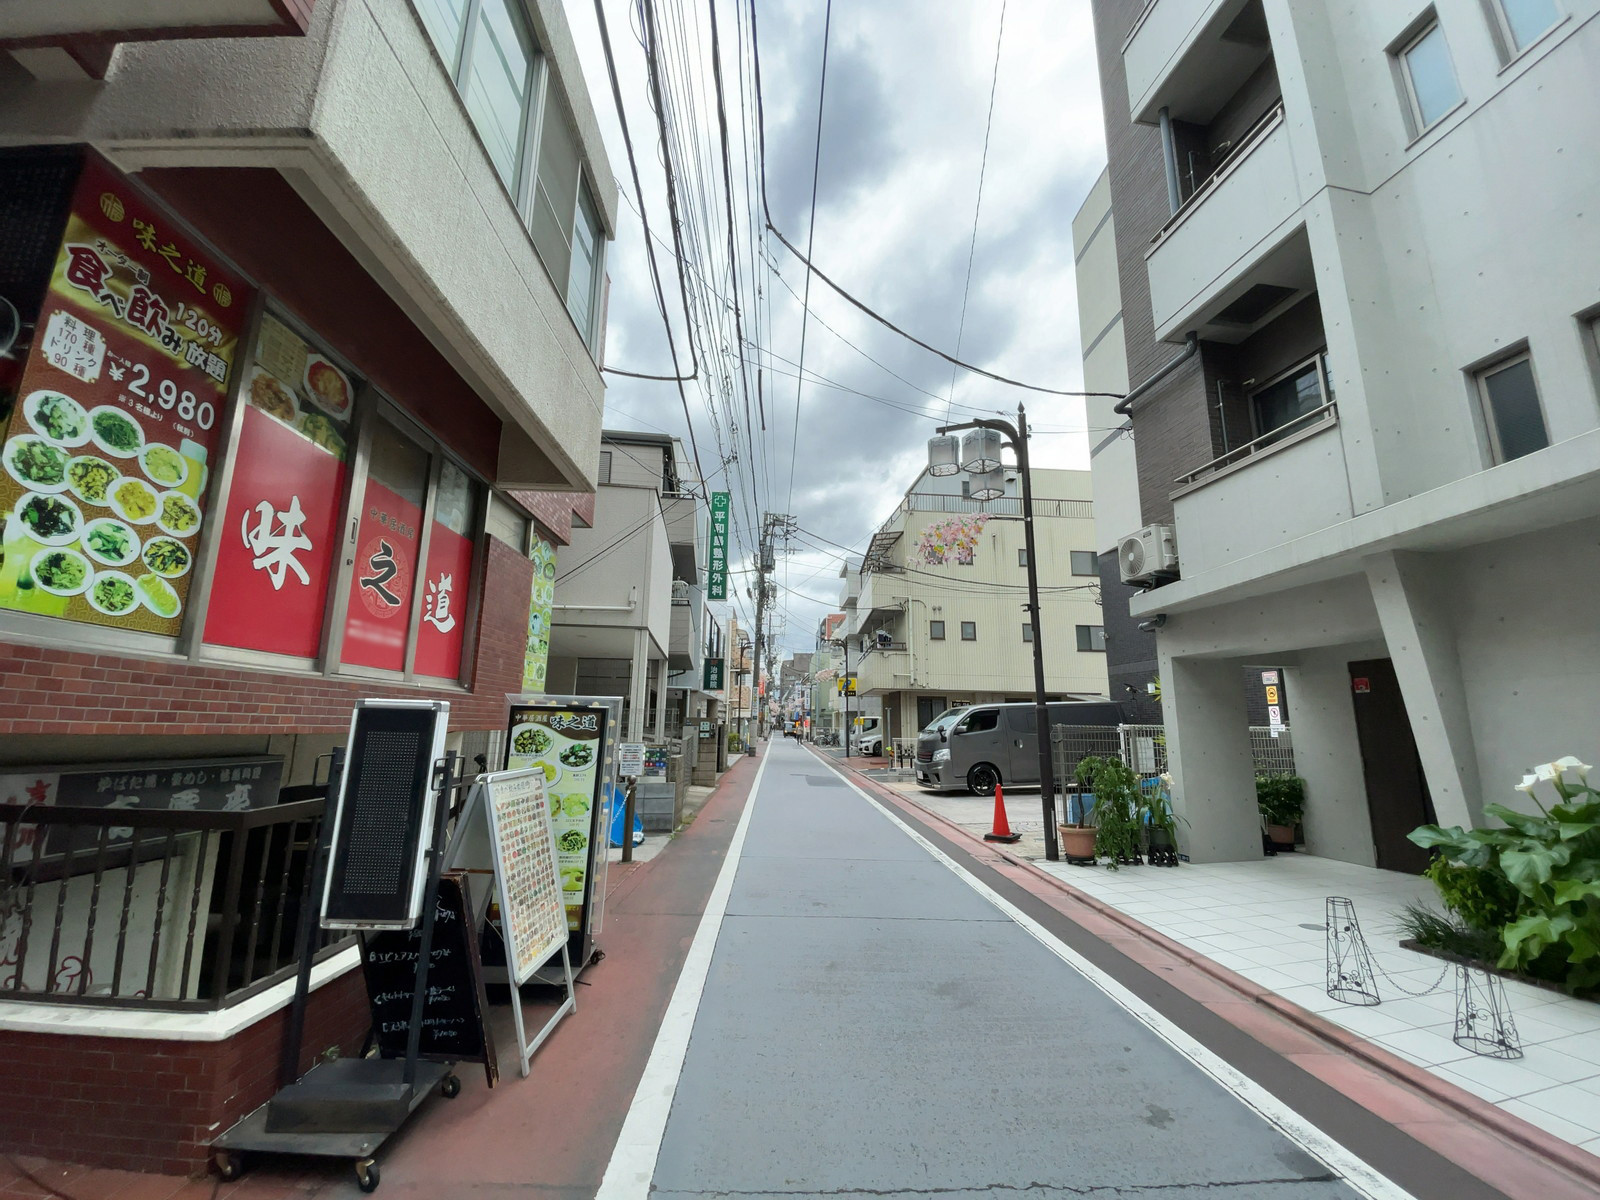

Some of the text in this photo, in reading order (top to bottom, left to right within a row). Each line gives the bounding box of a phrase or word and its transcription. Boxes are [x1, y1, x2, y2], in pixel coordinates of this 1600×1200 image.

[133, 218, 208, 294] 味之道
[63, 315, 97, 343] 料理
[175, 302, 223, 346] 120分
[50, 336, 97, 367] ドリンク
[711, 511, 726, 596] 平和島整形外科
[550, 714, 597, 731] 味之道
